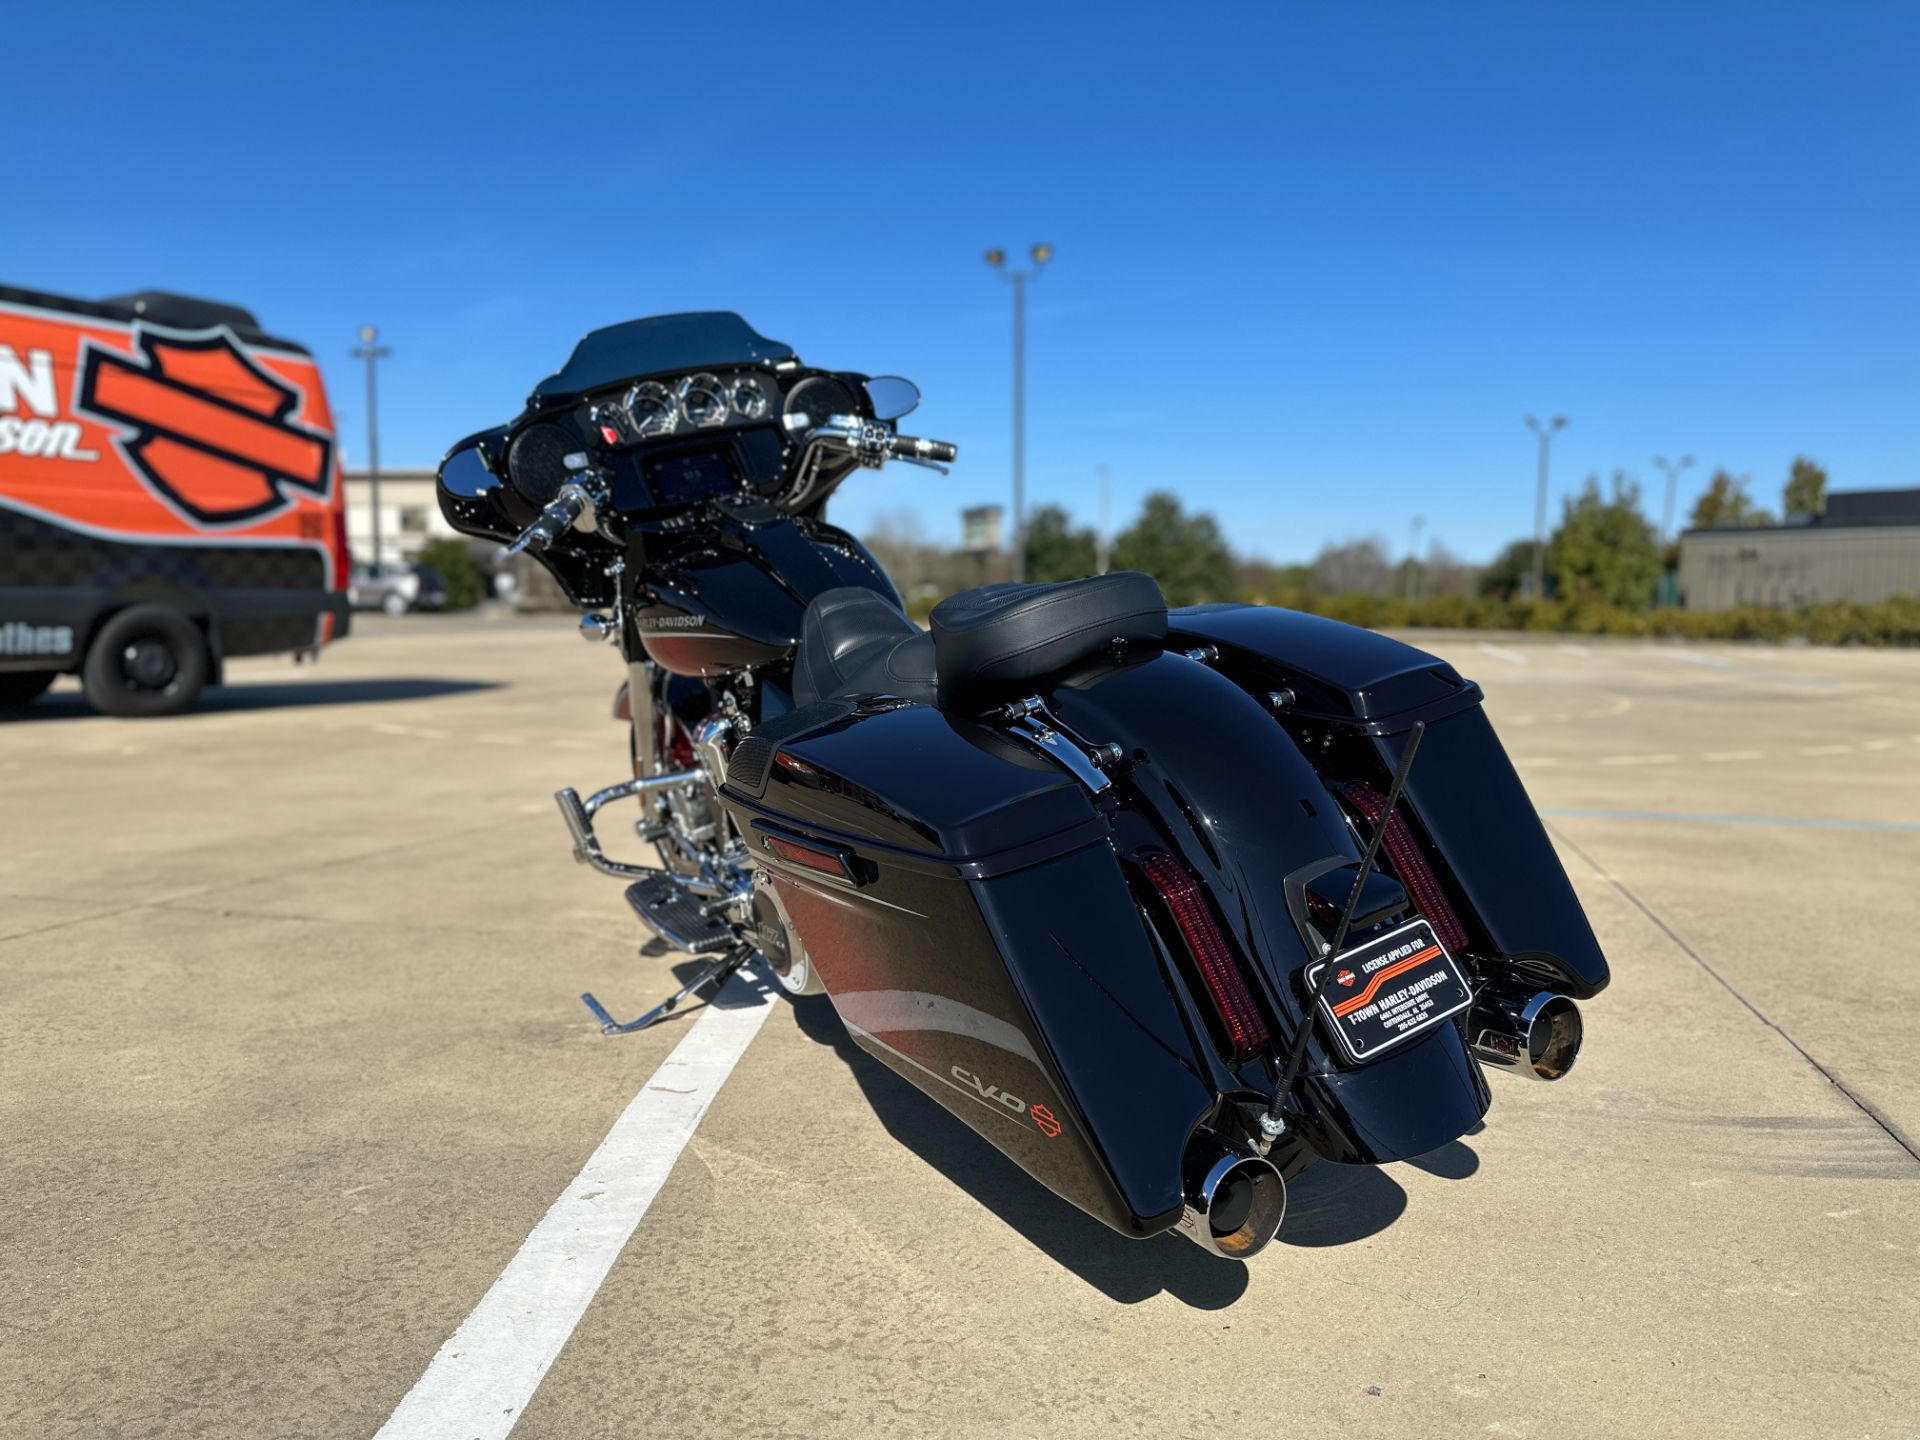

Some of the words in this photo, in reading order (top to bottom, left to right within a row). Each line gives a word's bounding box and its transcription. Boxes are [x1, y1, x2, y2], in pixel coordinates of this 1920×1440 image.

[1361, 954, 1390, 974] LICENSE
[1387, 944, 1413, 963] APPLIED
[1410, 938, 1426, 951] FOR
[1347, 1003, 1380, 1026] T-TOWN
[1378, 969, 1448, 1012] HARLEY-DAVIDSON
[951, 1065, 1026, 1113] CVO
